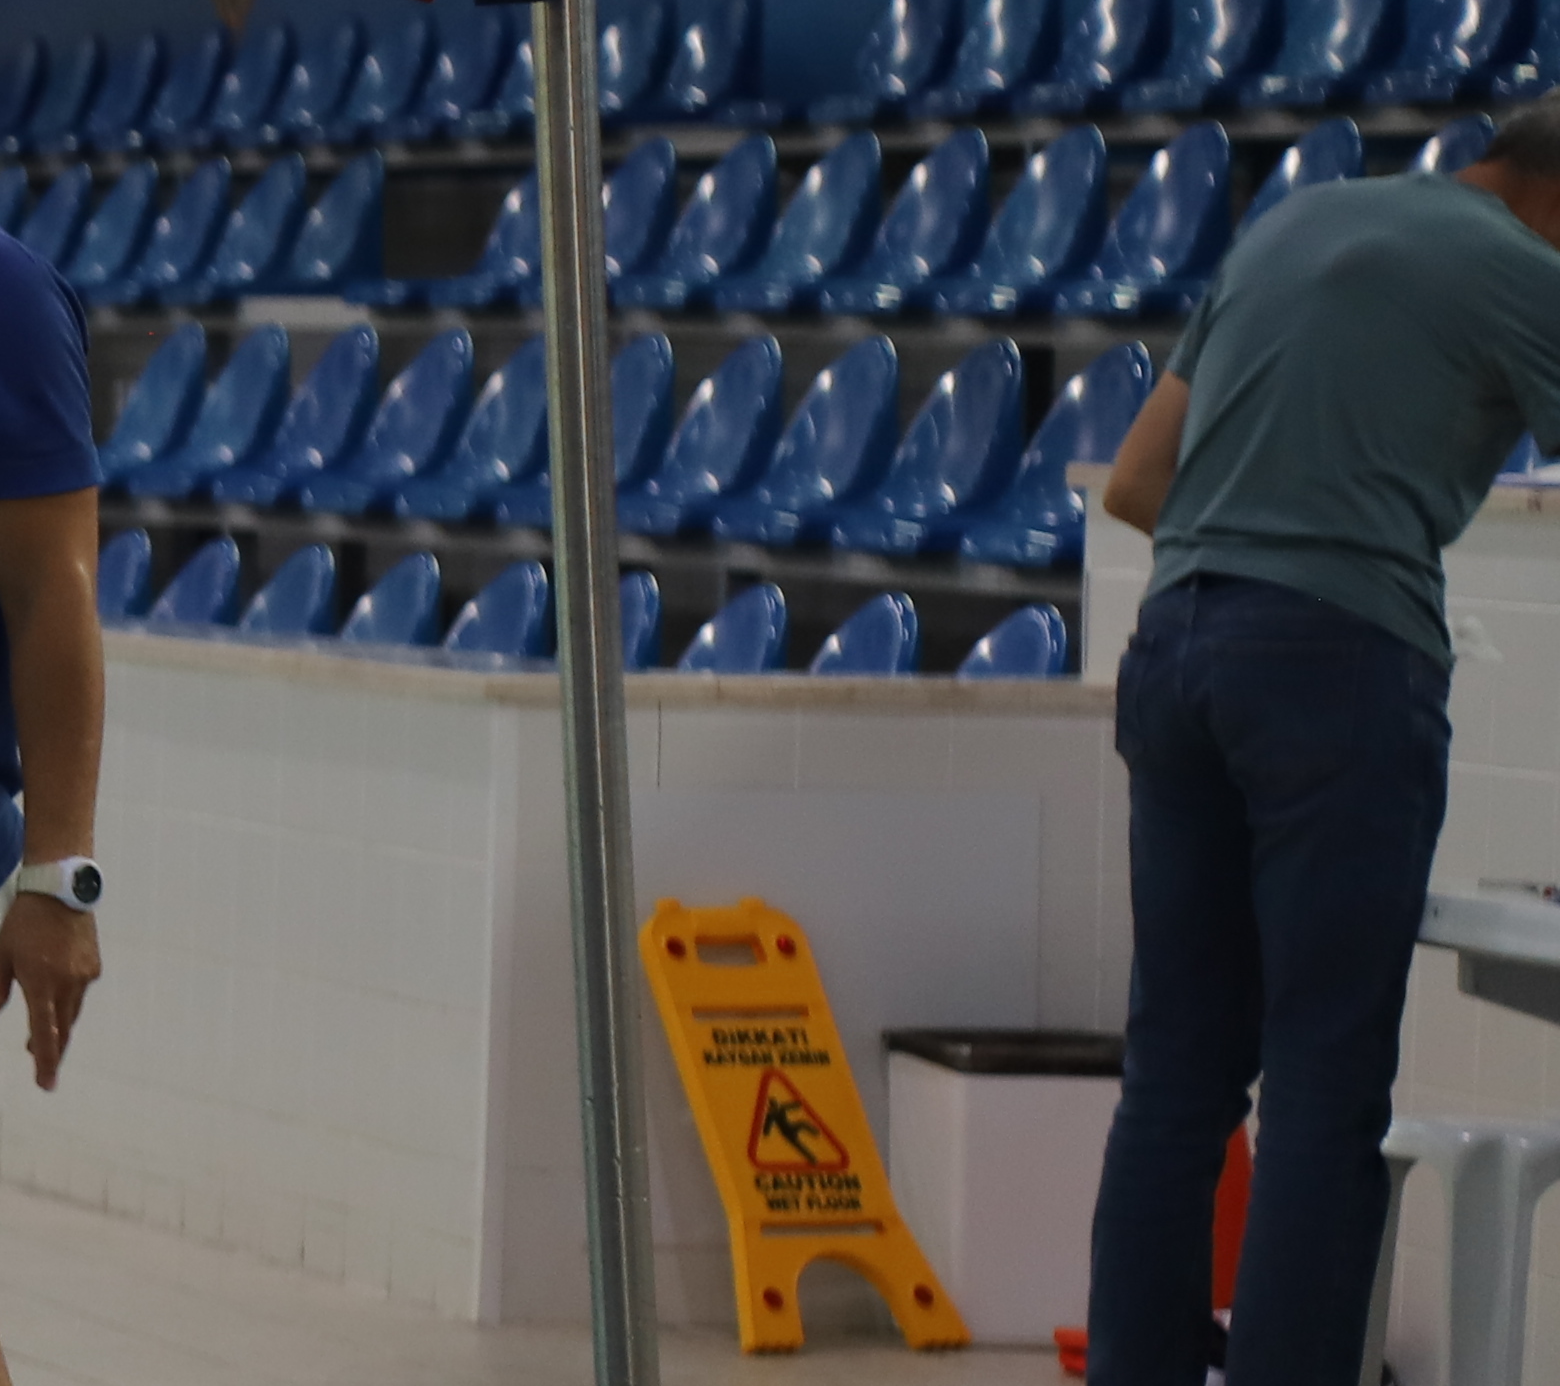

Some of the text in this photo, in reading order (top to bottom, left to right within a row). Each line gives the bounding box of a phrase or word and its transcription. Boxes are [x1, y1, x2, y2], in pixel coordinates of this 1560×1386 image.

[754, 1174, 861, 1192] CAUTION
[767, 1198, 861, 1211] WET FLOOR
